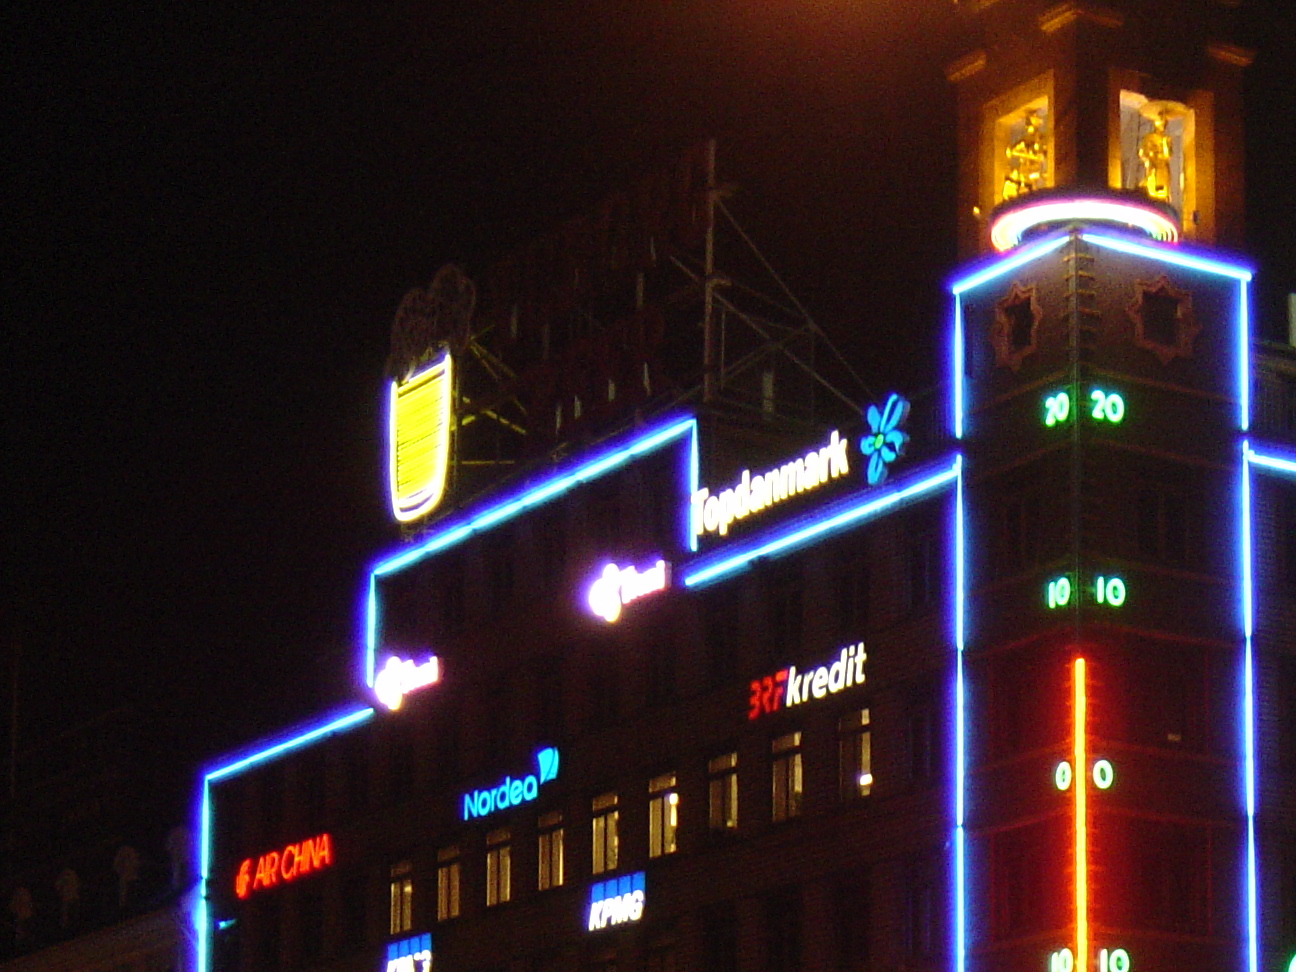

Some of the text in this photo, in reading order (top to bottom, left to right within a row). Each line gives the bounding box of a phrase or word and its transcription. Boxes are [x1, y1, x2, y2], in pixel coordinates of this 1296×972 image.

[1045, 392, 1070, 427] 20
[1091, 389, 1125, 423] 20
[691, 430, 849, 536] Topdanmark
[1048, 577, 1071, 609] 10
[1096, 576, 1126, 607] 10
[1092, 759, 1114, 790] 0
[464, 776, 538, 821] Nordea
[588, 889, 645, 932] KPMG
